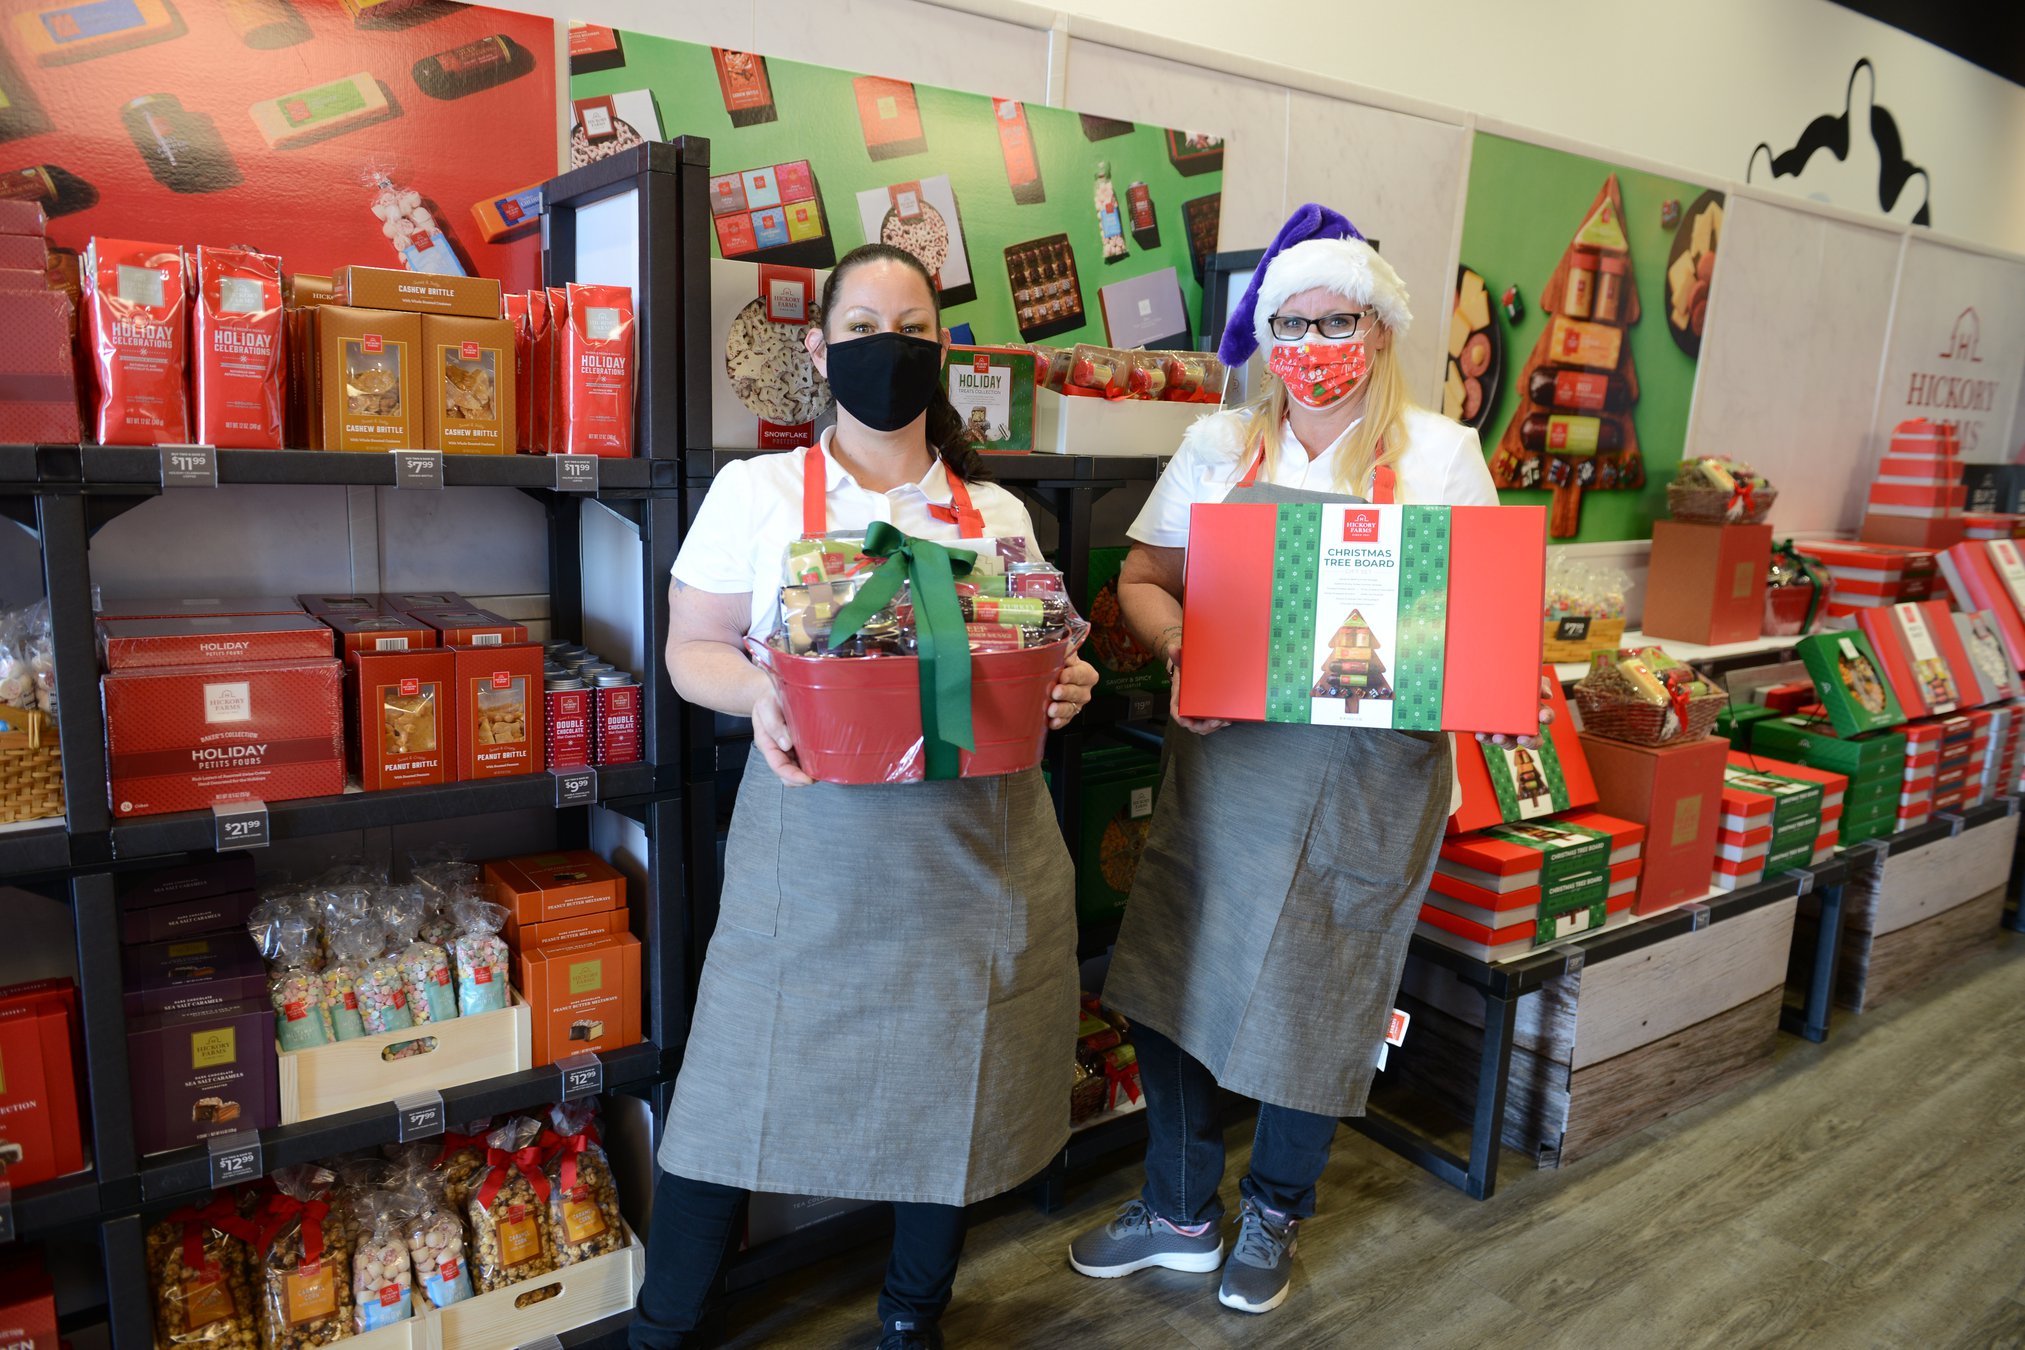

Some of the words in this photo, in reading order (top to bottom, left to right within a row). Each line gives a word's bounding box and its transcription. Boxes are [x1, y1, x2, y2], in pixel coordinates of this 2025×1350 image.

[398, 285, 426, 294] CASHEW
[428, 287, 454, 297] BRITTLE
[112, 322, 173, 340] HOLIDAY
[112, 336, 172, 349] CELEBRATIONS
[214, 330, 272, 348] HOLIDAY
[214, 344, 271, 356] CELEBRATIONS
[582, 355, 626, 368] HOLIDAY
[581, 367, 624, 375] CELEBRATIONS
[959, 374, 1001, 389] HOLIDAY
[1906, 373, 1999, 412] HICKORY
[346, 425, 374, 433] CASHEW
[377, 426, 403, 434] BRITTLE
[473, 430, 498, 438] BRITTLE
[764, 431, 808, 439] SNOWFLAKE
[171, 456, 206, 470] $1199
[407, 461, 433, 473] $799
[565, 464, 590, 475] $1199
[1328, 548, 1392, 557] CHRISTMAS
[1324, 558, 1351, 567] TREE
[1354, 559, 1395, 568] BOARD
[200, 642, 249, 651] HOLIDAY
[1106, 678, 1128, 686] SAVORY
[210, 698, 245, 706] HICKORY
[556, 720, 584, 728] DOUBLE
[608, 716, 634, 724] DOUBLE
[556, 727, 584, 735] CHOCOLATE
[201, 733, 224, 742] BAKER'S
[192, 744, 268, 761] HOLIDAY
[478, 752, 500, 761] PEANUT
[502, 750, 527, 759] BRITTLE
[199, 760, 229, 769] PETITS
[233, 758, 261, 766] FOURS
[385, 763, 410, 772] PEANUT
[412, 760, 438, 769] BRITTLE
[566, 780, 588, 792] $999
[225, 820, 260, 836] $2199
[1551, 850, 1577, 861] CHRISTMAS
[1577, 846, 1589, 856] TREE
[1589, 842, 1604, 853] BOARD
[1549, 884, 1574, 895] CHRISTMAS
[1575, 880, 1586, 890] TREE
[1587, 875, 1603, 886] BOARD
[585, 896, 611, 905] MELTAWAYS
[194, 913, 221, 922] CARAMELS
[579, 929, 605, 937] MELTAWAYS
[573, 972, 598, 982] HICKORY
[192, 998, 223, 1007] CARAMELS
[591, 996, 618, 1006] MELTAWAYS
[197, 1042, 230, 1053] HICKORY
[207, 1070, 233, 1078] CHOCOLATE
[212, 1072, 244, 1083] CARAMELS
[570, 1071, 596, 1086] $1299
[220, 1155, 254, 1172] $1299
[573, 1208, 594, 1220] CARAMEL
[578, 1215, 591, 1223] CORN
[509, 1231, 529, 1241] CARAMEL
